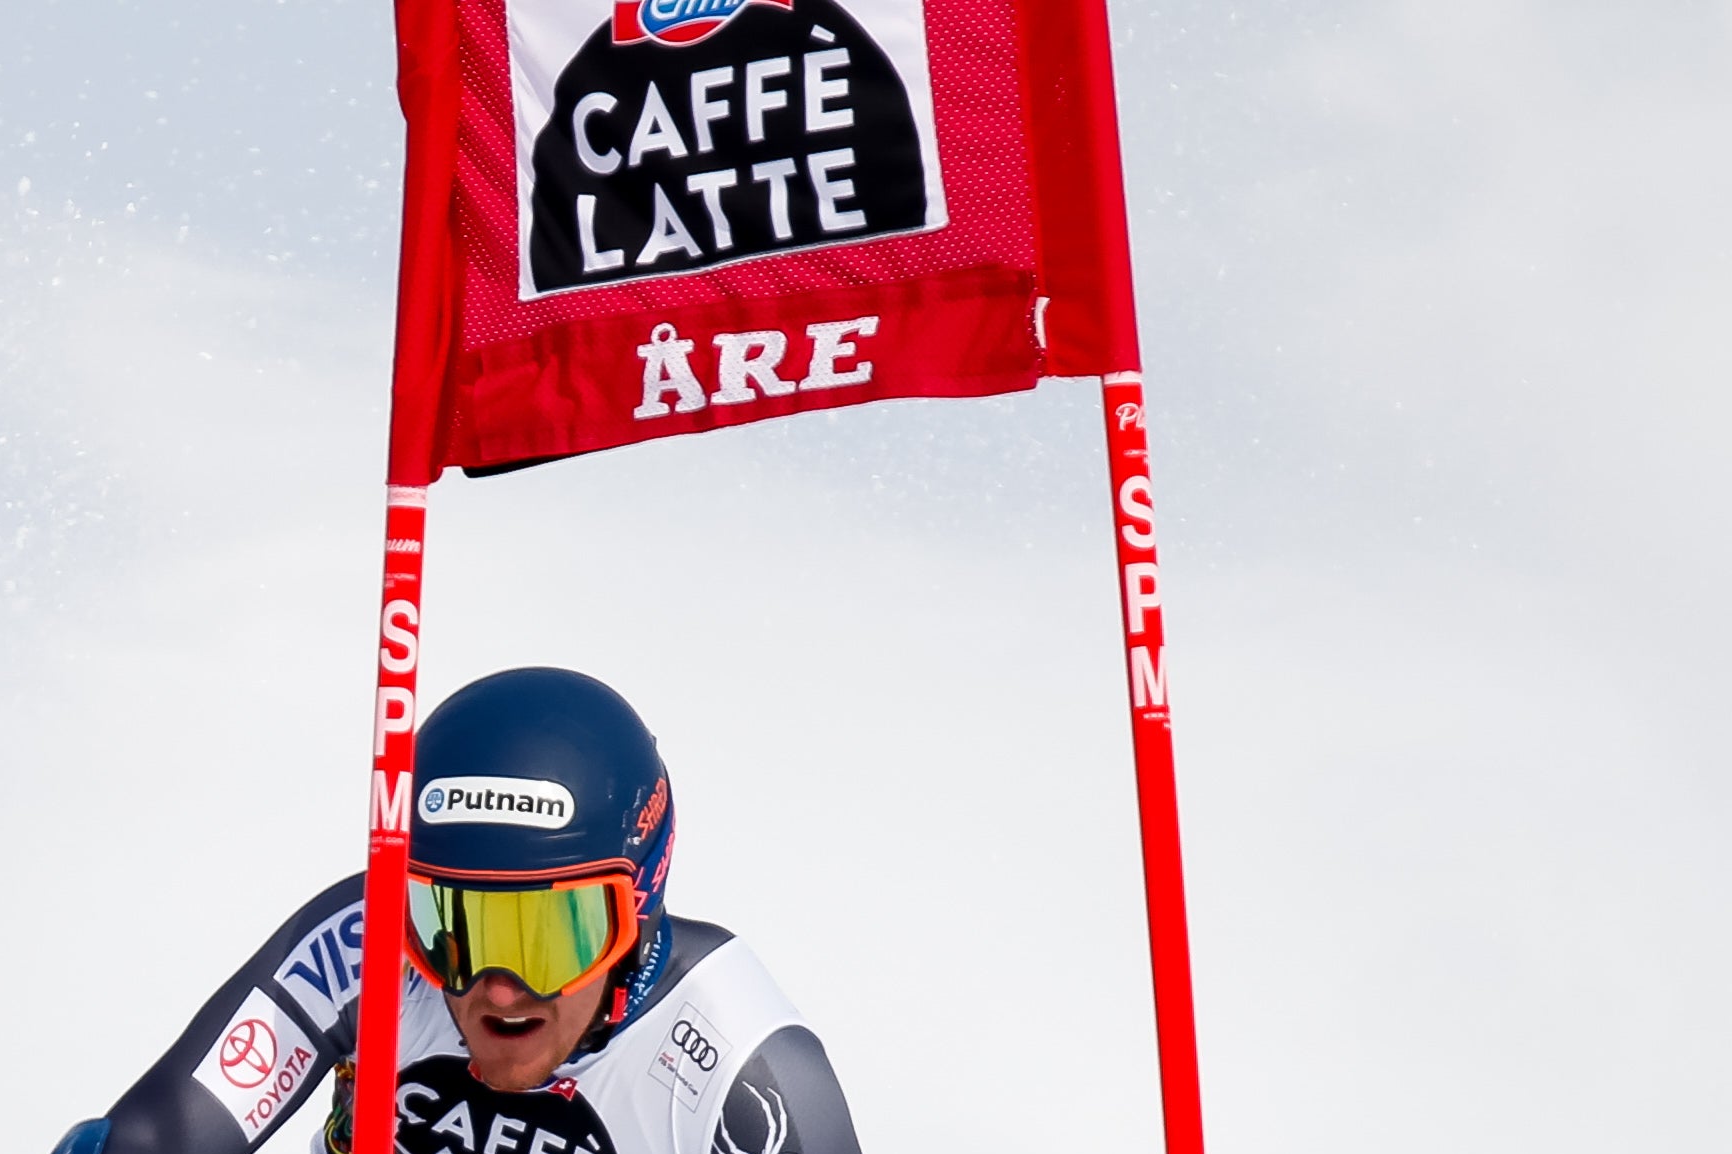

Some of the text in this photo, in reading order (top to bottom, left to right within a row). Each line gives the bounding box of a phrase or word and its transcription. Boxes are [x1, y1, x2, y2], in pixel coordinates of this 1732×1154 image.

[574, 25, 855, 175] CAFFÈ
[577, 148, 866, 274] LATTE
[632, 315, 880, 421] ÅRE
[370, 598, 418, 832] SPM
[446, 788, 565, 817] Putnam
[282, 910, 364, 1004] VIS
[244, 1045, 313, 1130] TOYOTA
